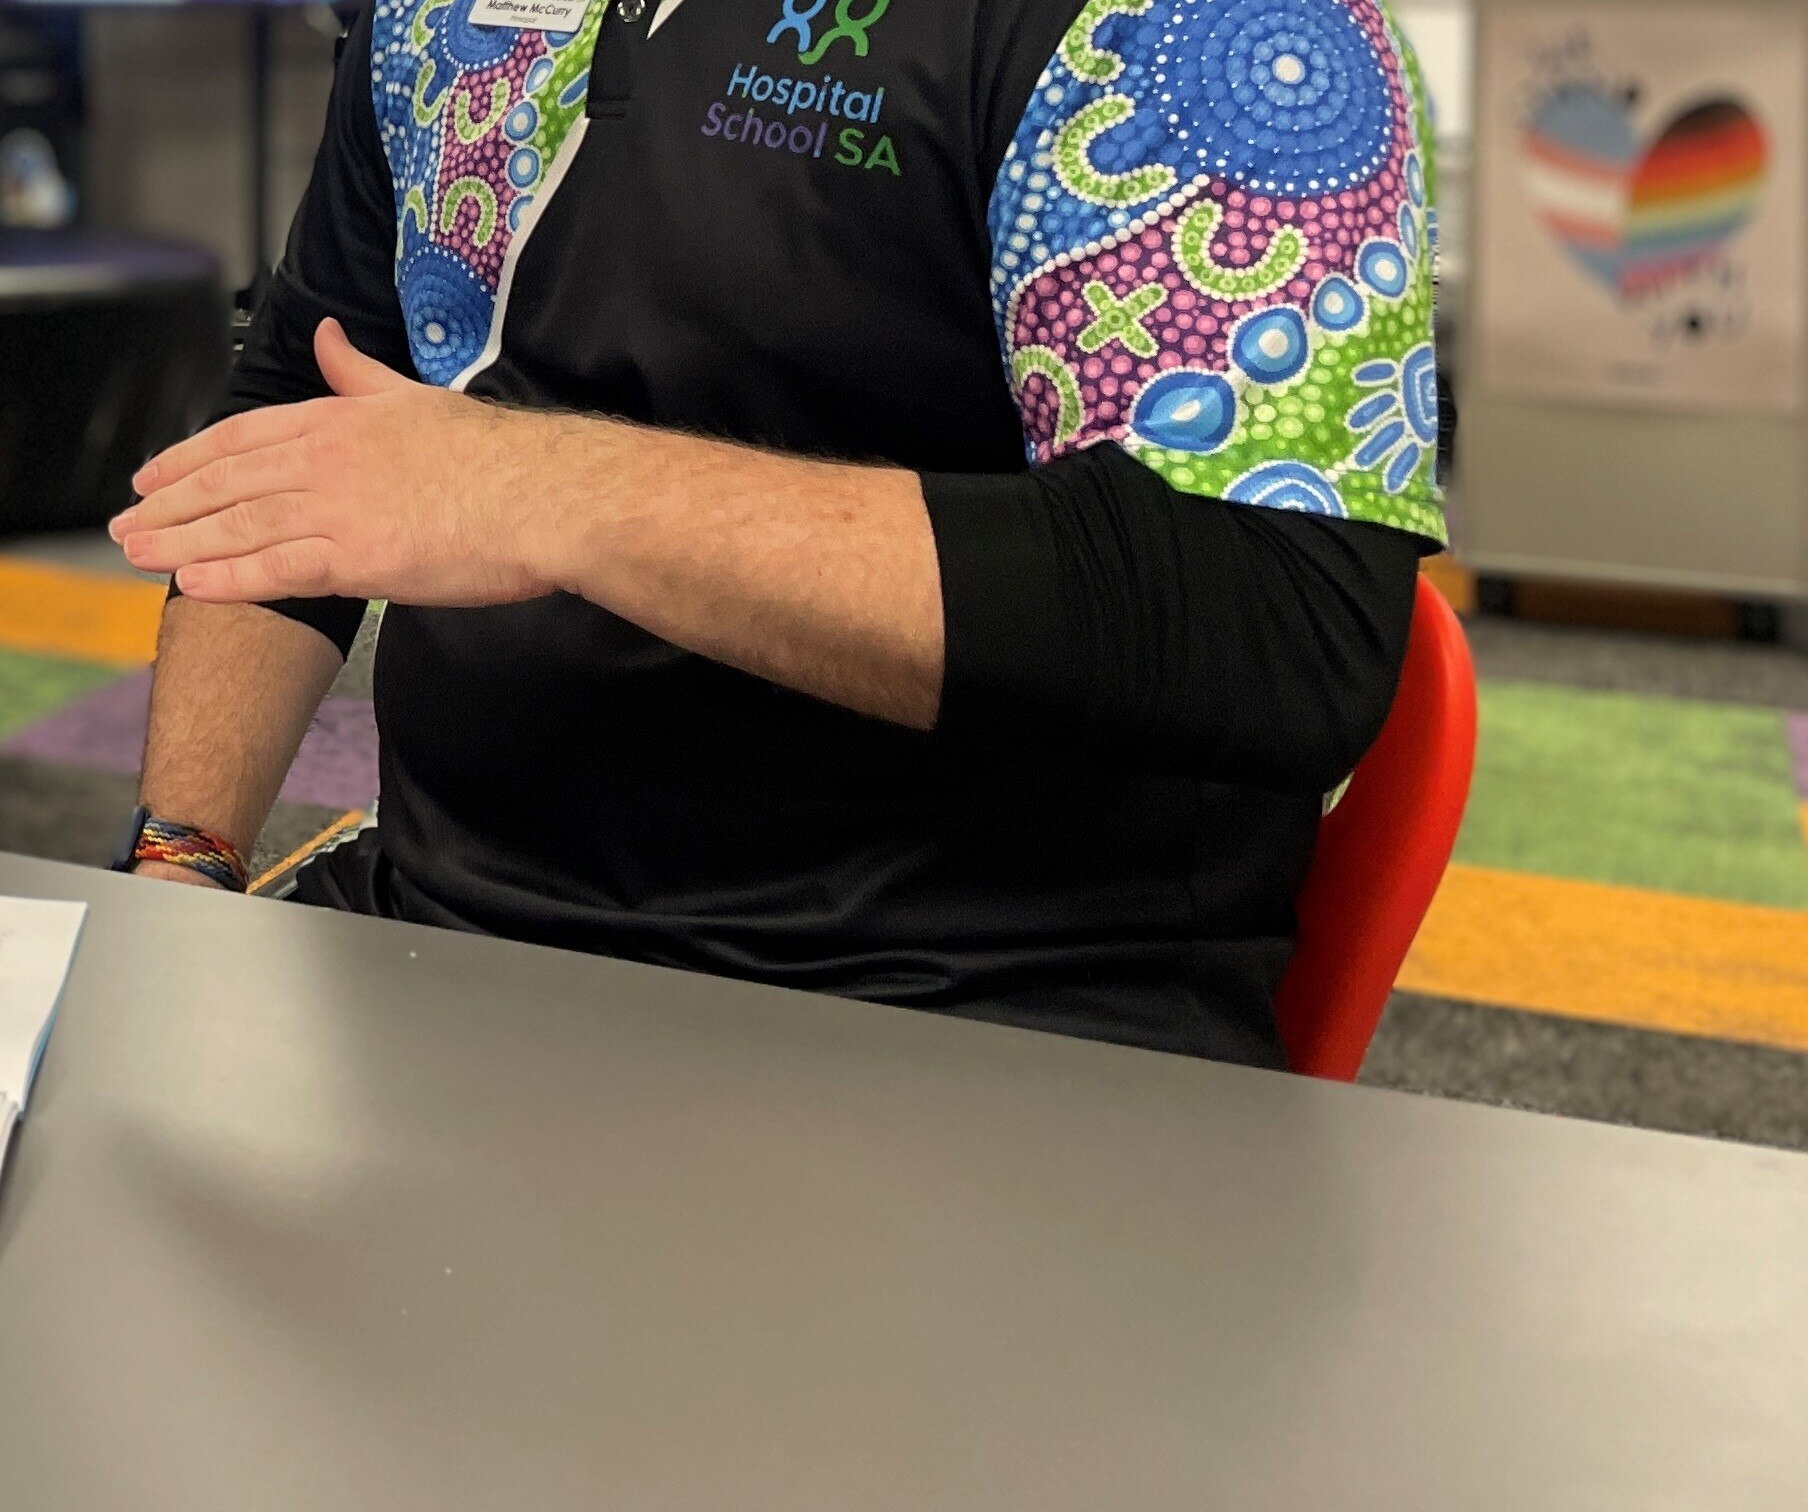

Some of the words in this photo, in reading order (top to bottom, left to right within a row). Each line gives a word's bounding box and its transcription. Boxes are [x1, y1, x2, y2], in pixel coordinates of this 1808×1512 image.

[486, 0, 528, 11] Matthew
[529, 4, 572, 18] McCurry
[727, 62, 884, 124] Hospital
[701, 100, 827, 158] School
[834, 126, 901, 176] SA
